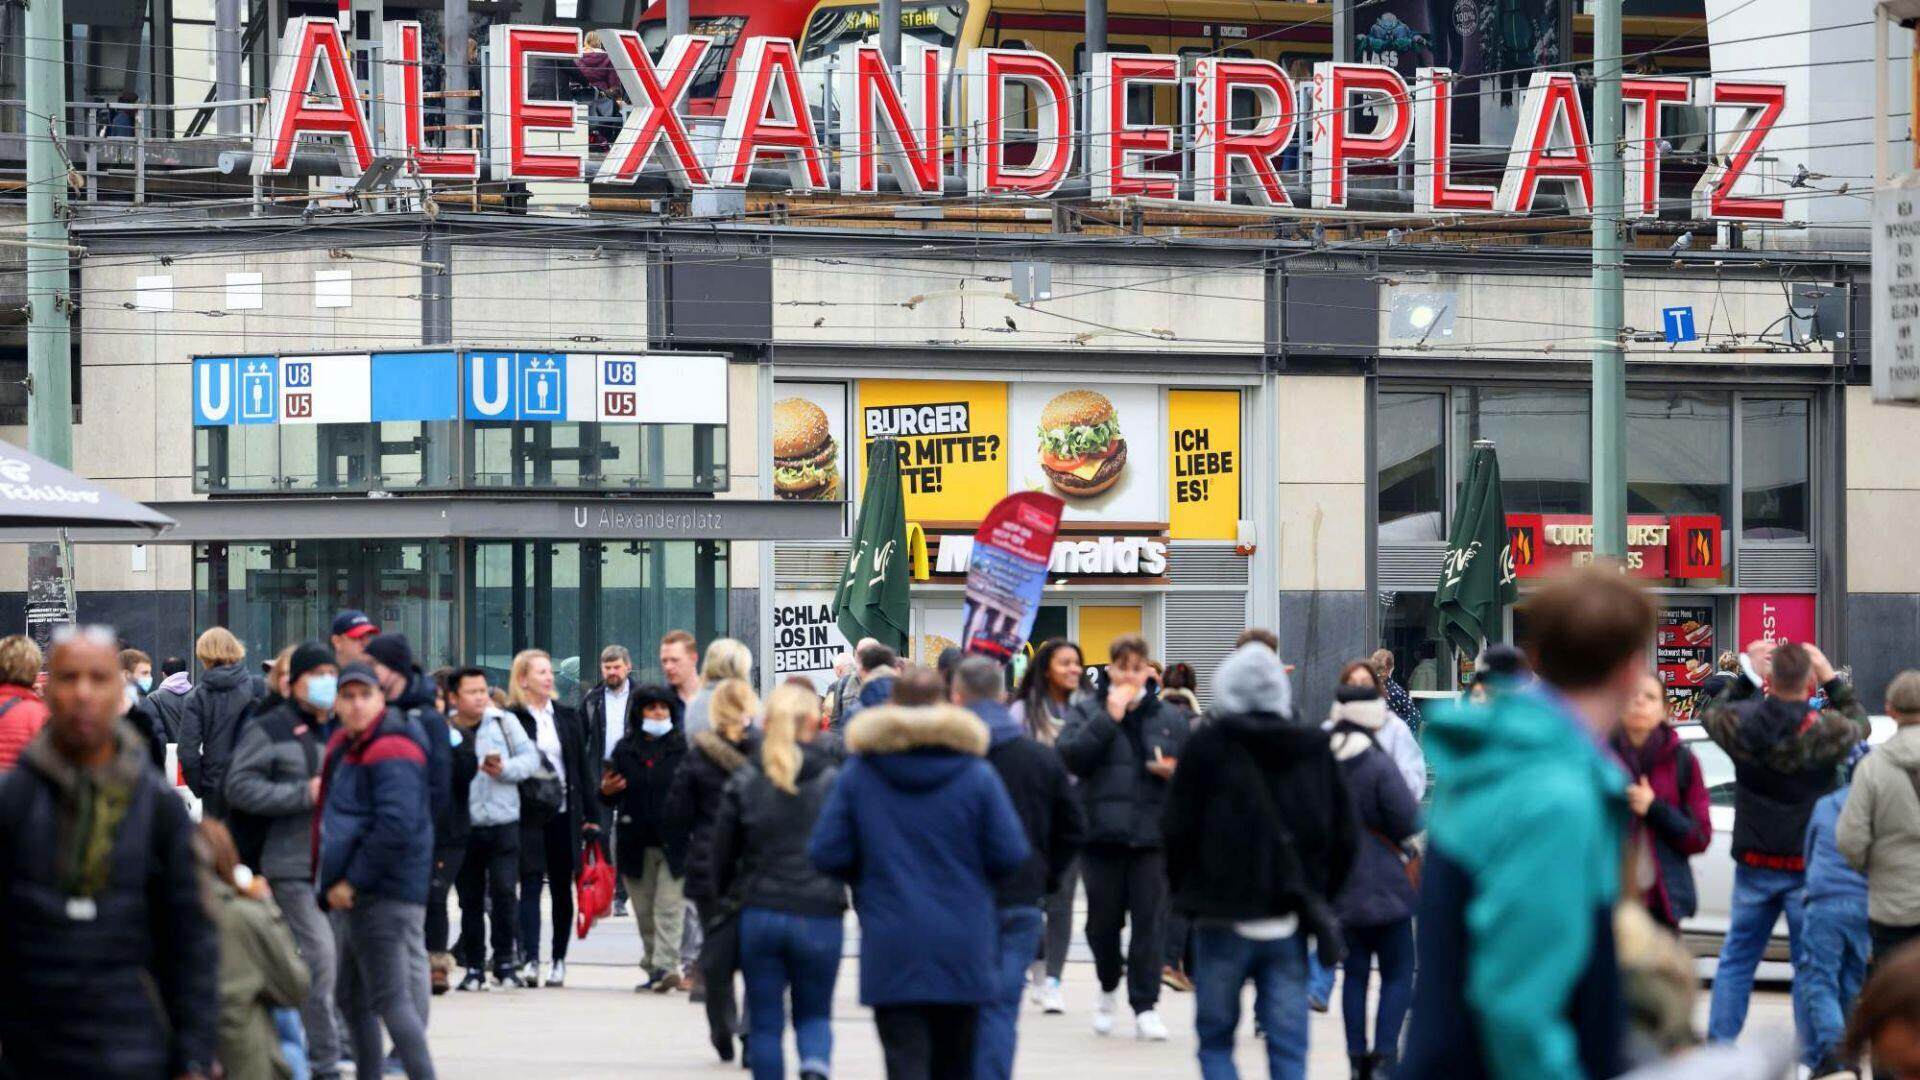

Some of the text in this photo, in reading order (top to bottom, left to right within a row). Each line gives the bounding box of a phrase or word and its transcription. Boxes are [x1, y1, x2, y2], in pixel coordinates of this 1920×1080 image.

[1362, 49, 1399, 68] LASS
[252, 15, 1787, 221] ALEXANDERPLATZ
[288, 365, 310, 385] U8
[608, 364, 634, 383] U8
[200, 363, 230, 421] U
[472, 357, 509, 416] U
[288, 395, 310, 416] U5
[608, 394, 634, 414] U5
[865, 403, 969, 437] BURGER
[915, 435, 1000, 466] MITTE?
[1174, 429, 1209, 452] ICH
[1175, 451, 1233, 477] LIEBE
[1176, 479, 1209, 503] ES!
[574, 506, 722, 533] U Alexanderplatz
[935, 535, 1167, 575] Mnald's
[809, 626, 828, 646] IN
